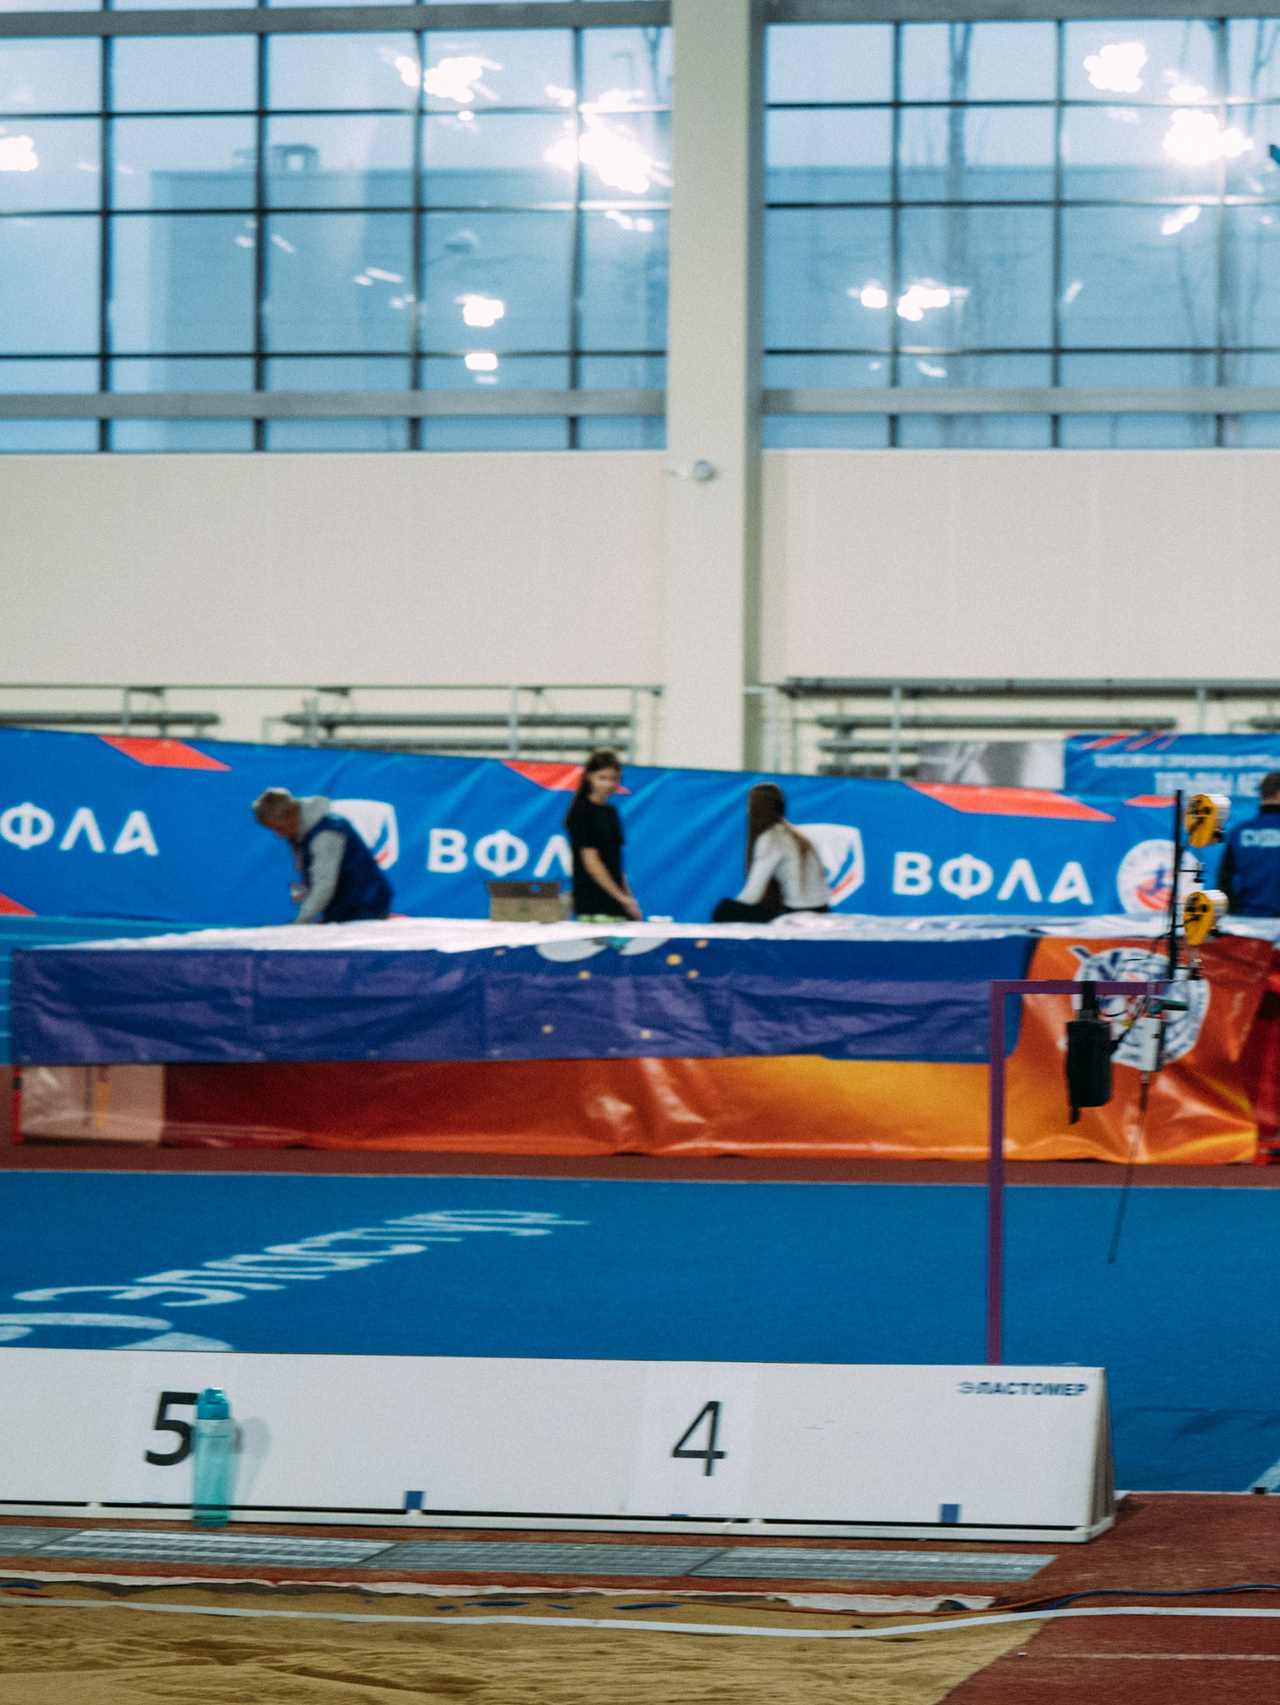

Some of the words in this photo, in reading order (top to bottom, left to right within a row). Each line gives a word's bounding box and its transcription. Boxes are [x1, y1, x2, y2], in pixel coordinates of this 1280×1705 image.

[0, 802, 159, 856] ФЛА
[892, 851, 1094, 906] ВФЛА
[957, 1381, 1089, 1397] ЭЛАСТОМЕР
[144, 1391, 200, 1466] 5
[670, 1400, 728, 1477] 4
